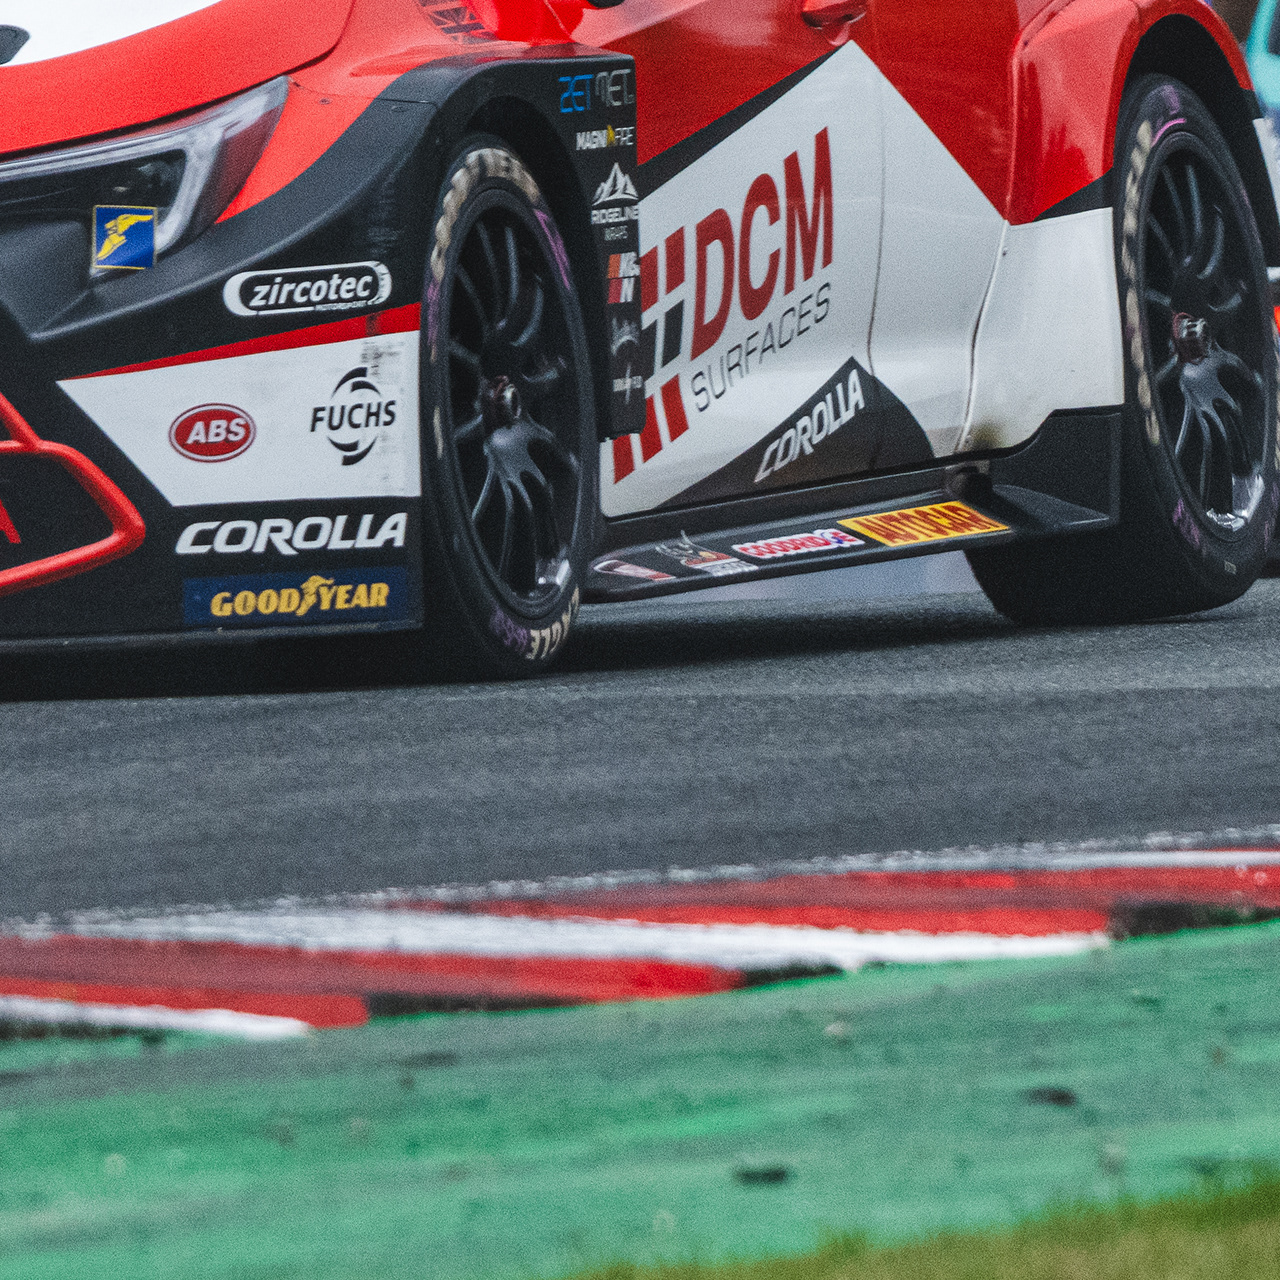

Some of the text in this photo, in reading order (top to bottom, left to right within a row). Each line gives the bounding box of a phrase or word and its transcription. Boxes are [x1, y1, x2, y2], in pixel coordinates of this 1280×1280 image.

[591, 204, 639, 224] RIDGELINE
[690, 126, 833, 362] DCM
[249, 272, 374, 307] zircotec
[690, 281, 832, 413] SURFACES
[186, 417, 247, 445] ABS
[310, 400, 396, 433] FUCHS
[754, 368, 865, 482] COROLLA
[175, 512, 409, 556] COROLLA
[853, 504, 1001, 545] AUTOCAR
[210, 574, 390, 617] GOODYEAR
